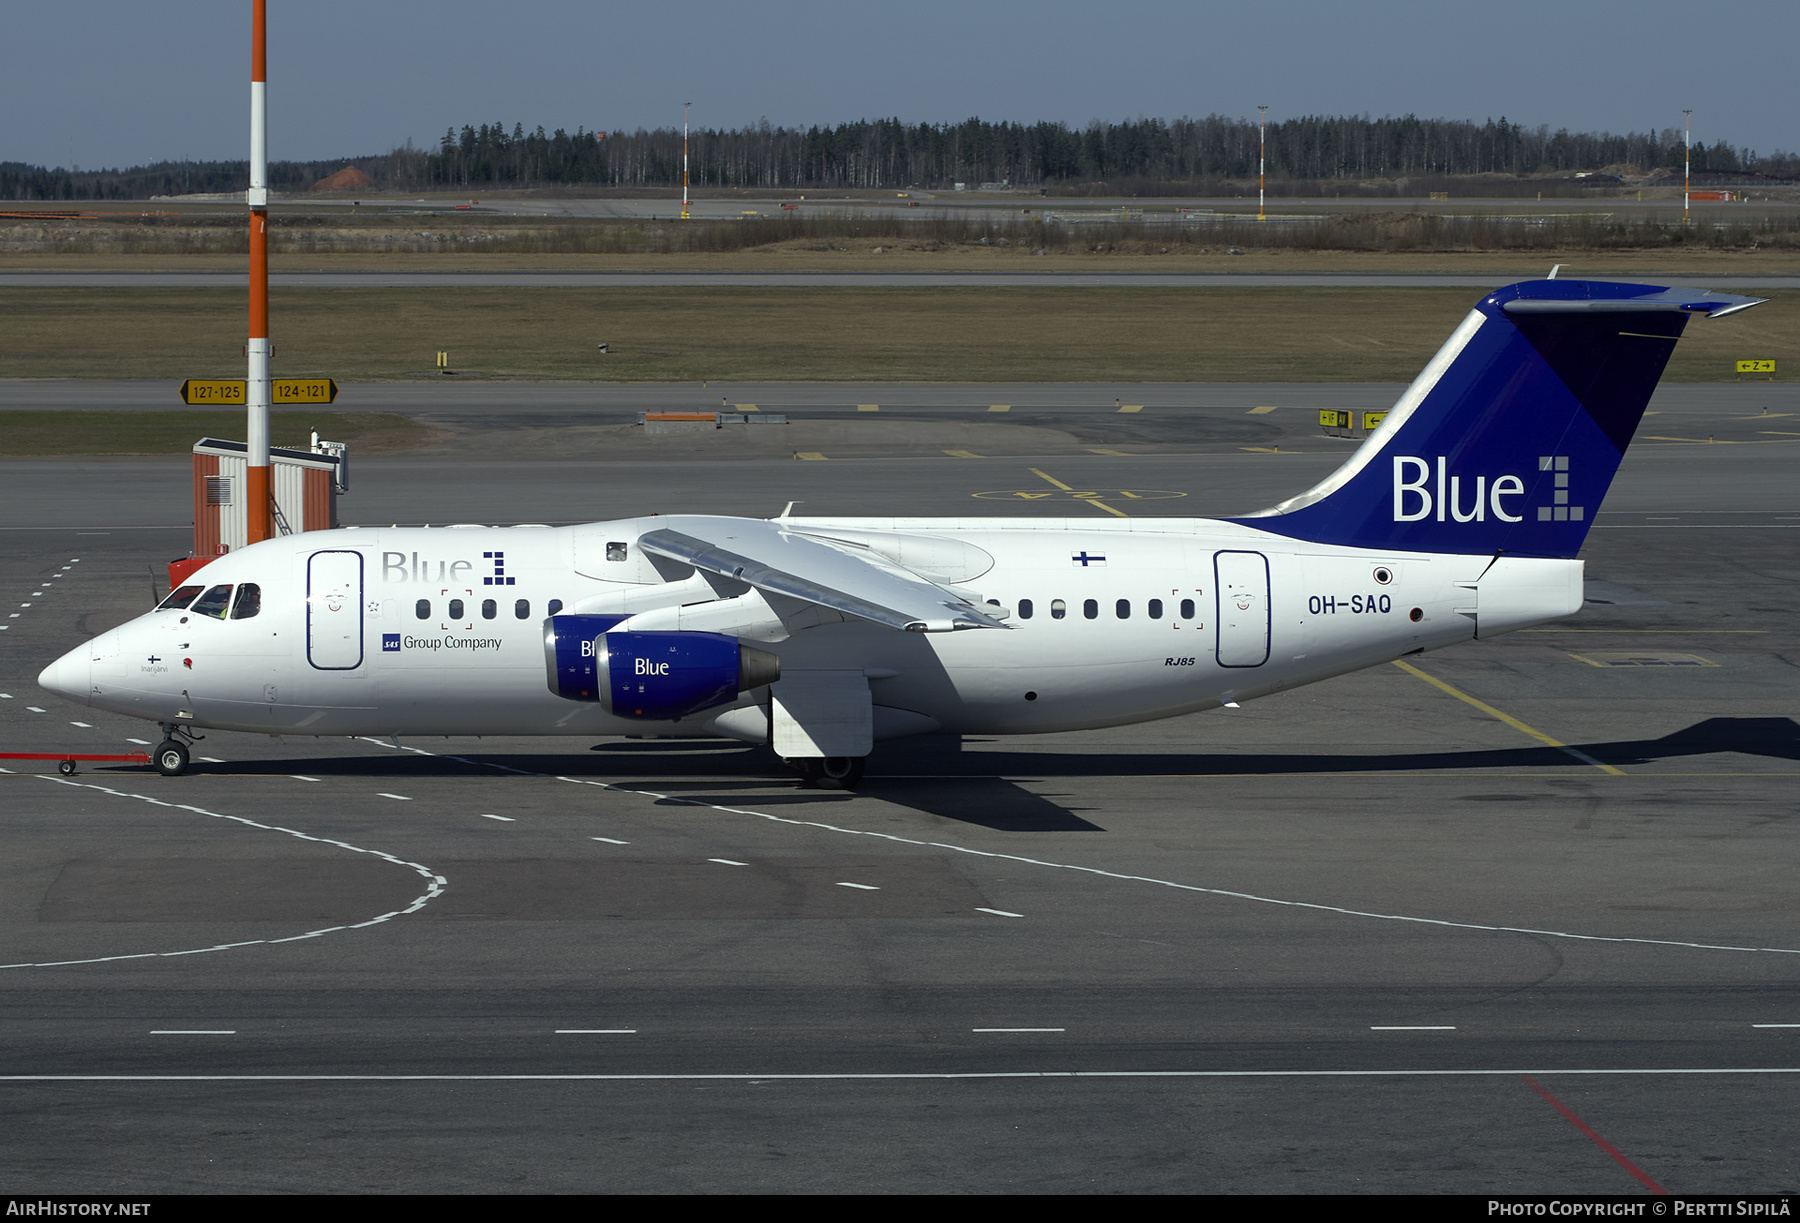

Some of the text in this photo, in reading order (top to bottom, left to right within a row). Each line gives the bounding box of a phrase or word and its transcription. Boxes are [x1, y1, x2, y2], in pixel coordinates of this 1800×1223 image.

[1753, 361, 1760, 371] Z
[194, 386, 240, 398] 127-125
[279, 385, 325, 397] 124-121
[1308, 594, 1392, 615] OH-SAQ
[383, 635, 503, 651] SAS Group Company
[581, 640, 596, 657] Bl
[635, 658, 669, 676] Blue
[1164, 657, 1196, 667] RJ85
